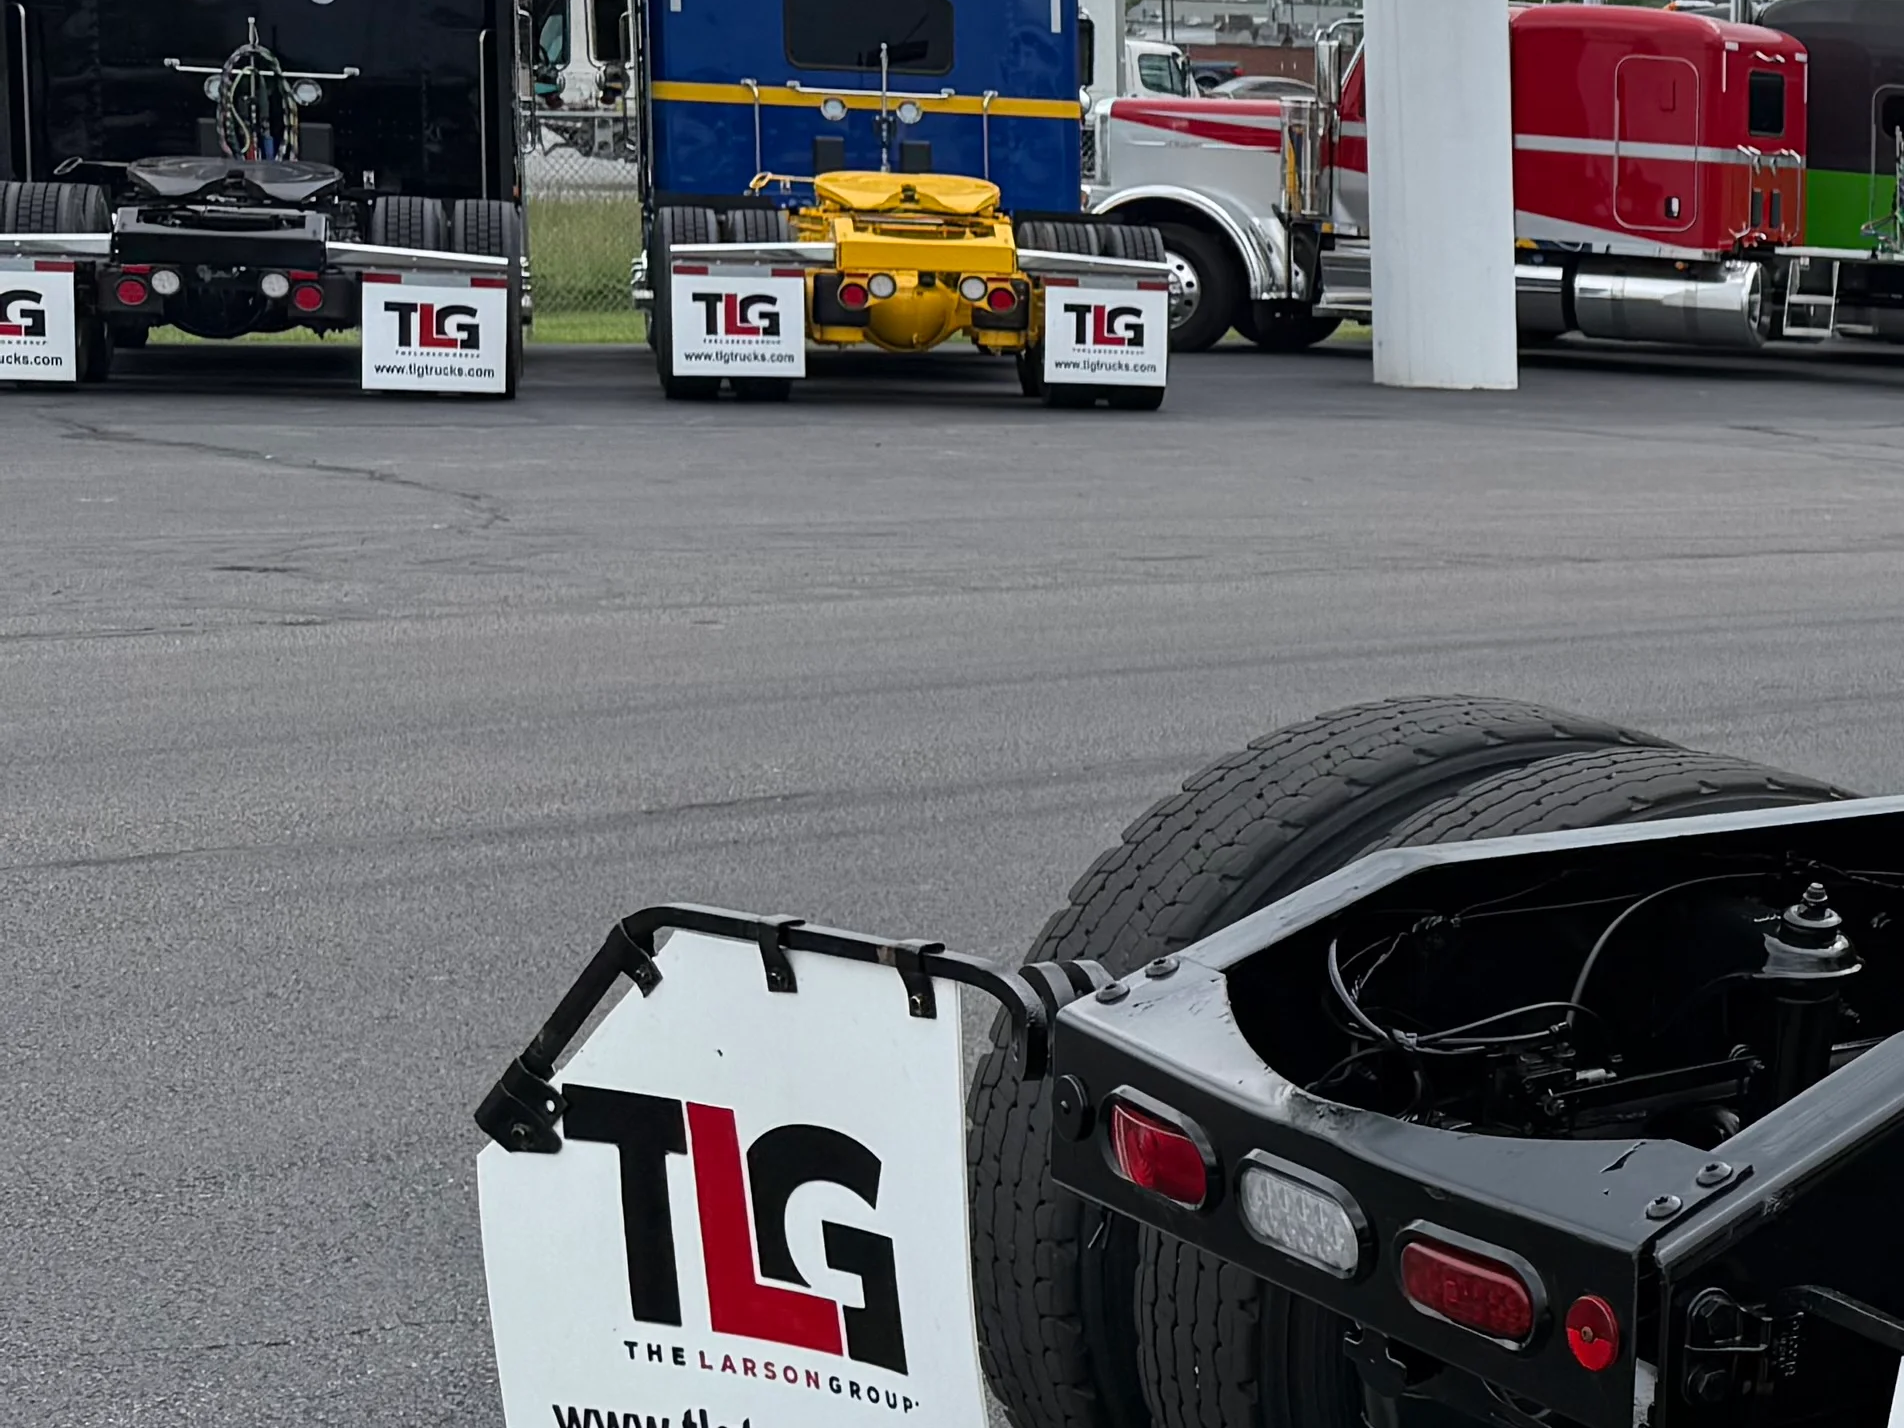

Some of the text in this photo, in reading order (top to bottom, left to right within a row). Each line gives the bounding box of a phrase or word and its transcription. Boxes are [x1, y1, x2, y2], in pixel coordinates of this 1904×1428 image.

[384, 301, 480, 350] TLG
[692, 292, 780, 336] TLG
[1064, 303, 1144, 347] TLG
[374, 362, 495, 378] www.tlgtrucks.com
[684, 351, 795, 364] www.tlgtrucks.com
[1055, 358, 1157, 373] www.tlgtrucks.com
[562, 1083, 908, 1376] TLG
[624, 1340, 914, 1413] THE LARSON GROUP
